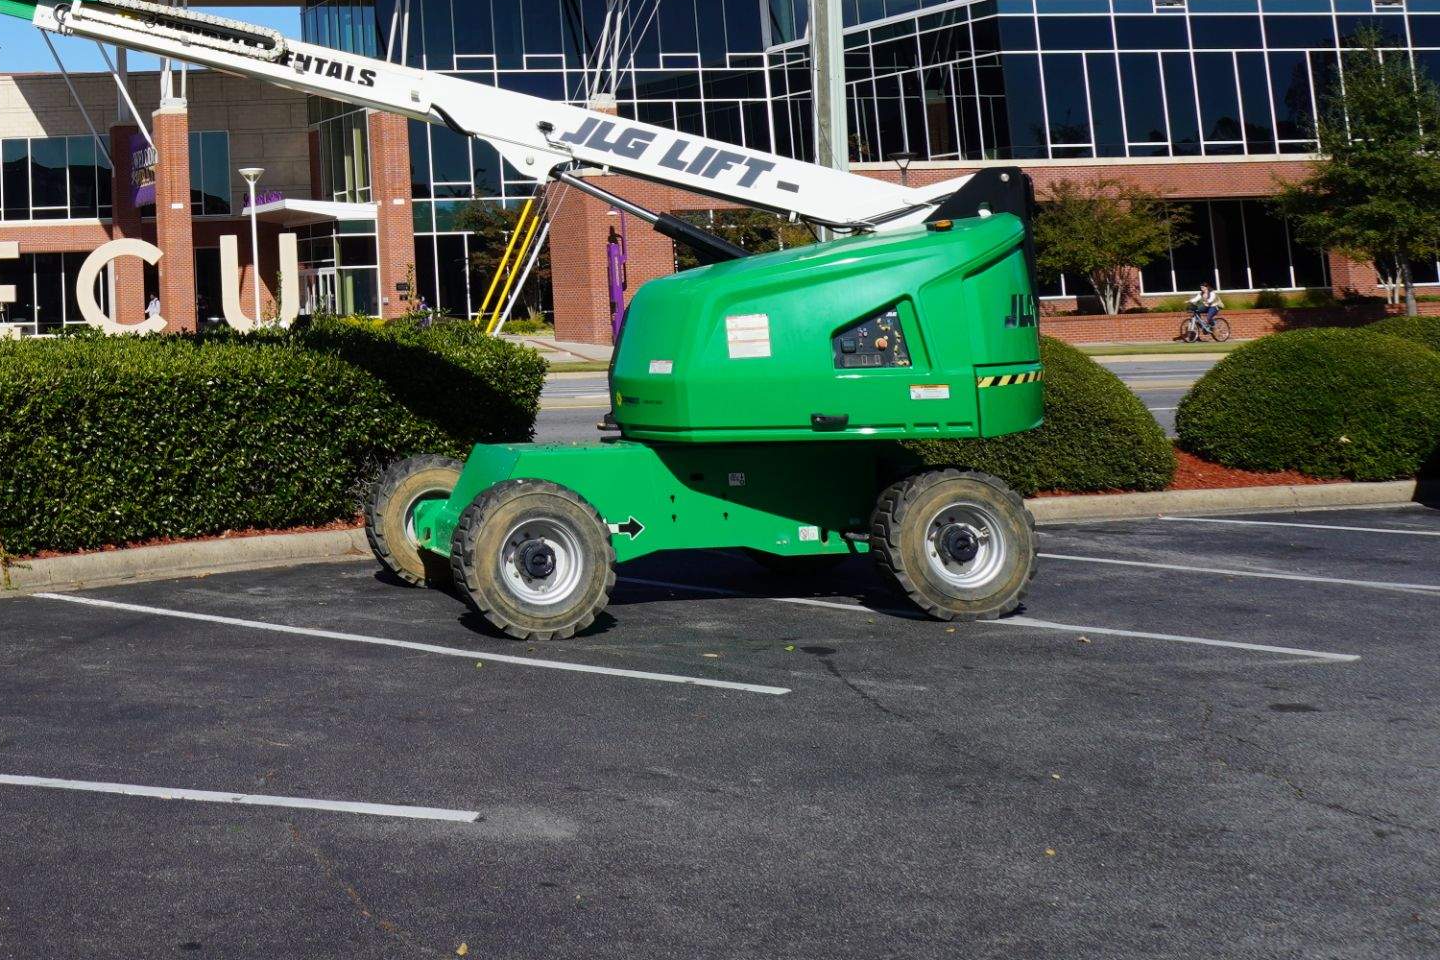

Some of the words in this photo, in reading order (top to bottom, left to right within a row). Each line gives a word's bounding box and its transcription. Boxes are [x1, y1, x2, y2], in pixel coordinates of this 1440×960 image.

[276, 49, 377, 87] ENTALS
[559, 116, 658, 160] JLG
[657, 139, 776, 189] LIFT
